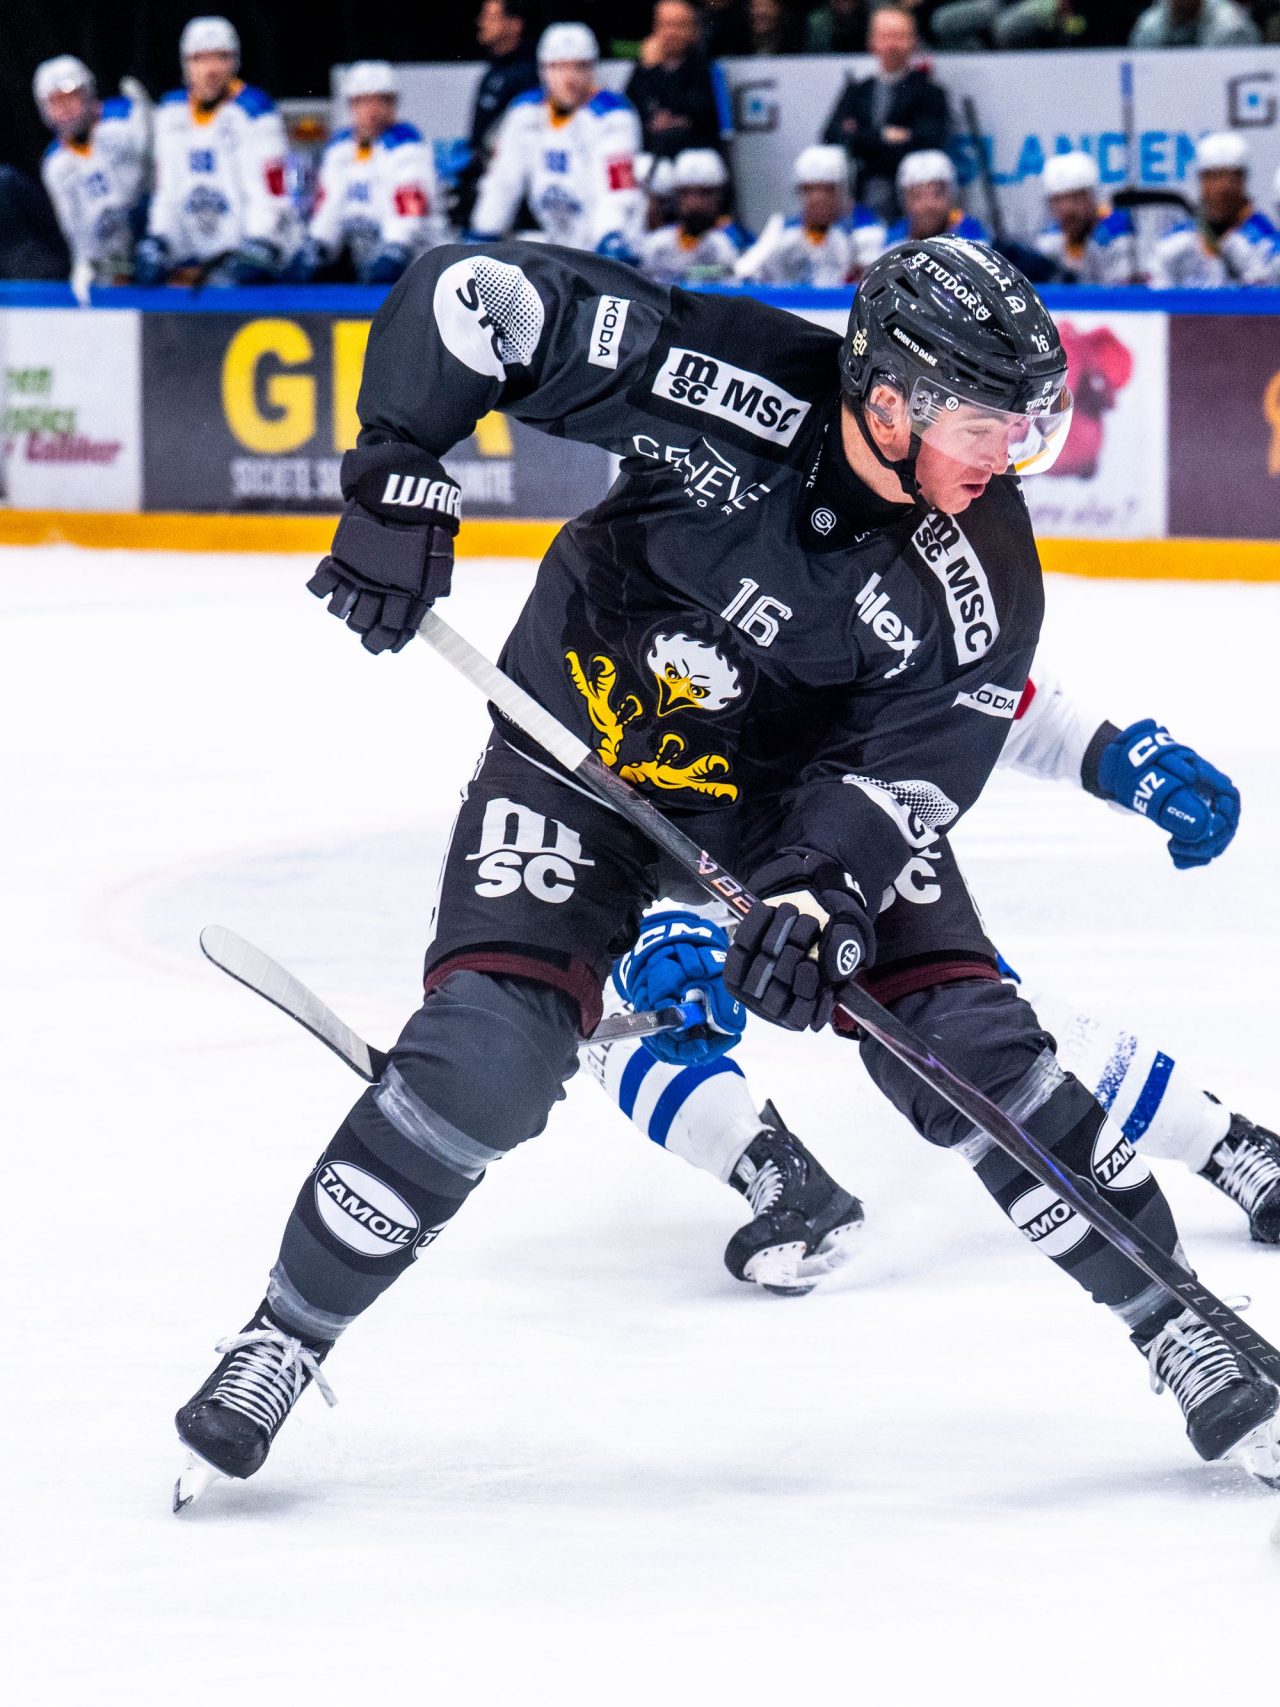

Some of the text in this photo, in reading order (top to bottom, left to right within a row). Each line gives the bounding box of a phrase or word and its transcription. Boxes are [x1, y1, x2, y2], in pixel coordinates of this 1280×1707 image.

[925, 260, 978, 310] TUDOR
[597, 299, 621, 358] KODA
[1031, 334, 1050, 354] 16
[918, 348, 938, 367] DARE
[720, 378, 801, 433] MSC
[381, 473, 462, 518] WAR
[720, 577, 793, 648] 16
[946, 556, 993, 653] MSC
[972, 690, 1015, 711] ODA
[1128, 732, 1176, 767] CC
[1133, 771, 1165, 815] EVZ
[1167, 806, 1196, 824] CCM
[1096, 1137, 1135, 1182] TAM
[320, 1167, 411, 1243] TAMOIL
[1022, 1203, 1073, 1241] AMO
[1176, 1282, 1280, 1365] FLYLITE
